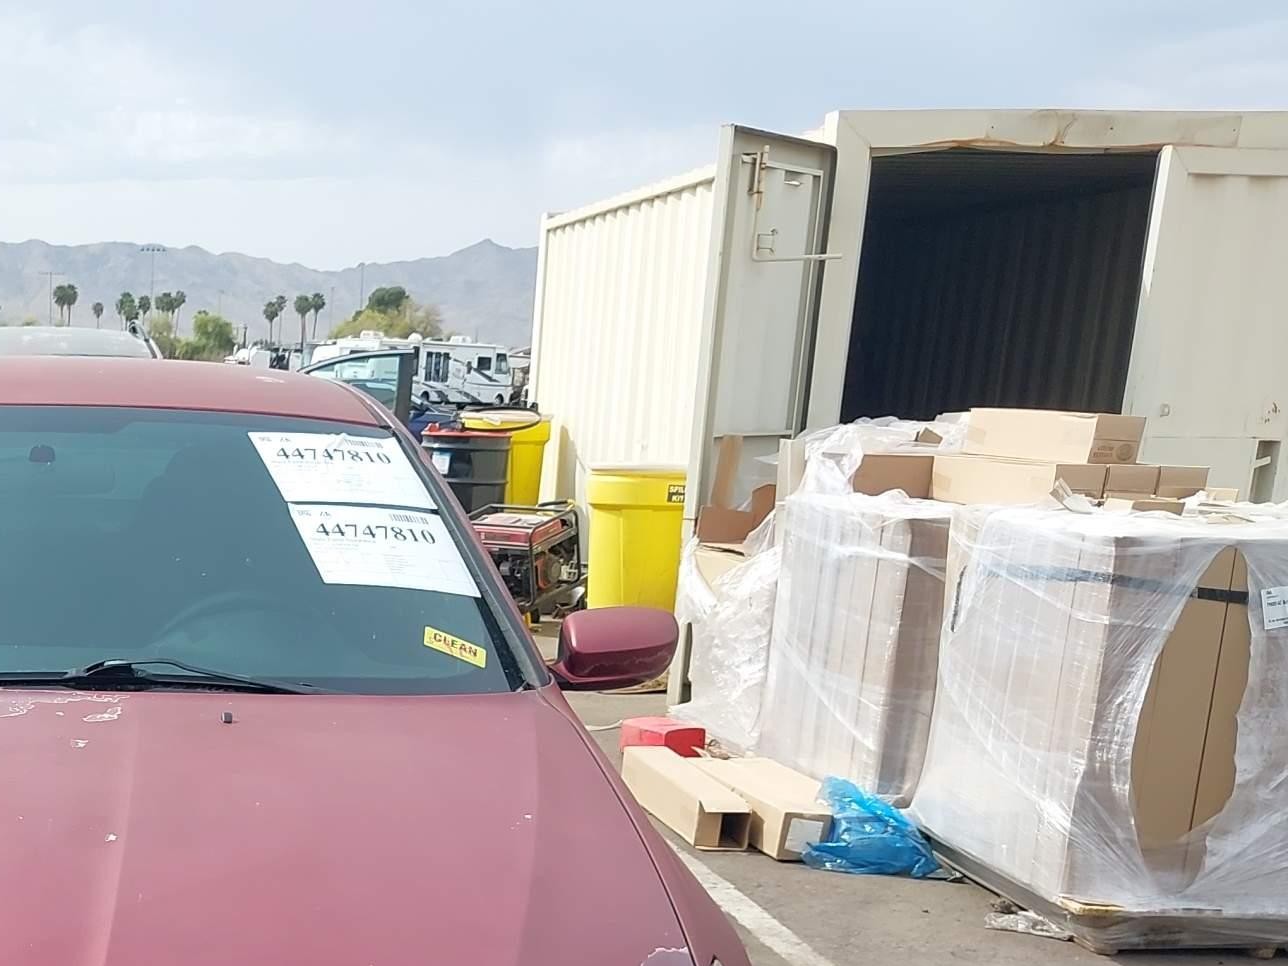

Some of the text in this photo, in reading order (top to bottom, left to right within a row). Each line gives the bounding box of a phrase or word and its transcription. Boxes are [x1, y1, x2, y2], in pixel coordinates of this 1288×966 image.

[276, 447, 392, 465] 44747810
[316, 522, 436, 545] 44747810
[433, 632, 478, 657] CLEAN
